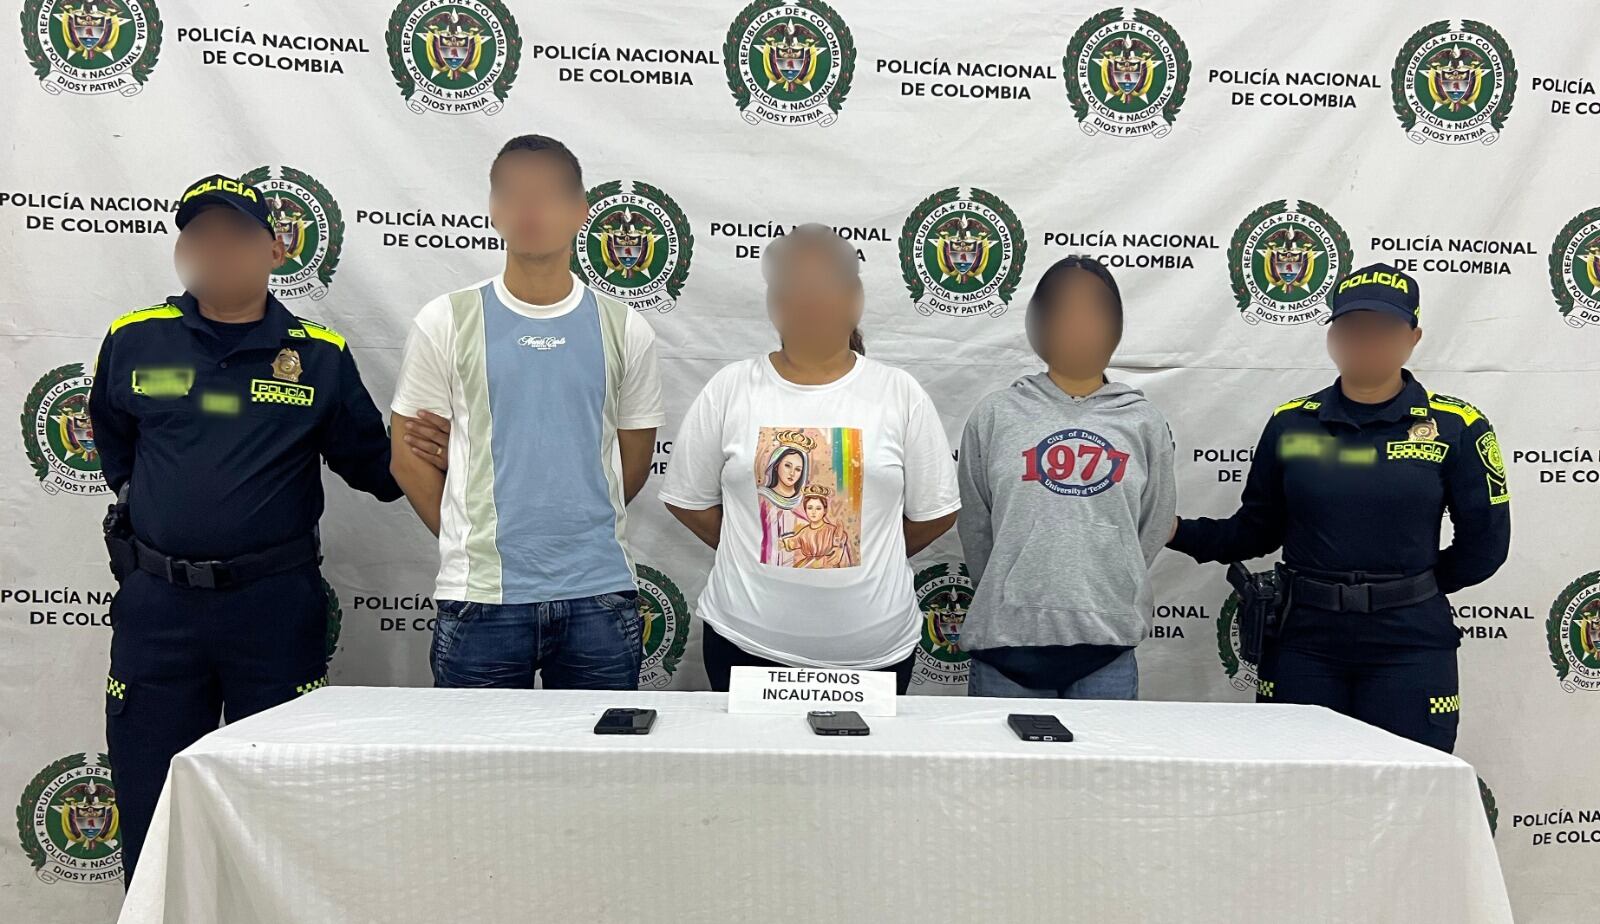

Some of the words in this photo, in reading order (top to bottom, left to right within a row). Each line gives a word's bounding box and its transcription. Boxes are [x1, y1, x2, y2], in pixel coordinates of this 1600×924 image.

[474, 4, 504, 56] COLOMBIA
[178, 26, 255, 45] POLICÍA
[263, 34, 369, 53] NACIONAL
[810, 15, 839, 68] COLOMBIA
[534, 43, 610, 60] POLICÍA
[617, 48, 719, 64] NACIONAL
[1147, 29, 1175, 81] COLOMBIA
[90, 52, 140, 78] NACIONAL
[203, 51, 226, 64] DE
[233, 52, 344, 74] COLOMBIA
[877, 58, 950, 75] POLICÍA
[958, 63, 1056, 79] NACIONAL
[1476, 39, 1502, 89] COLOMBIA
[90, 78, 126, 91] PATRIA
[455, 69, 500, 98] NACIONAL
[560, 68, 584, 82] DE
[590, 69, 693, 85] COLOMBIA
[1209, 68, 1280, 85] POLICÍA
[1286, 73, 1381, 88] NACIONAL
[902, 82, 925, 96] DE
[931, 84, 1030, 99] COLOMBIA
[1532, 78, 1595, 94] POLICÍA
[790, 80, 835, 110] NACIONAL
[1232, 92, 1254, 105] DE
[1260, 93, 1356, 108] COLOMBIA
[455, 97, 488, 111] PATRIA
[1127, 93, 1170, 121] NACIONAL
[1552, 100, 1570, 114] DE
[790, 109, 823, 122] PATRIA
[1455, 101, 1498, 130] NACIONAL
[1126, 120, 1158, 135] PATRIA
[1454, 128, 1486, 142] PATRIA
[0, 192, 84, 210] POLICÍA
[91, 197, 181, 212] NACIONA
[296, 188, 327, 241] COLOMBIA
[357, 209, 436, 226] POLICÍA
[27, 216, 54, 230] DE
[61, 218, 168, 234] COLOMBIA
[622, 196, 636, 204] DE
[647, 203, 676, 255] COLOMBIA
[711, 221, 785, 237] POLICÍA
[384, 234, 408, 247] DE
[415, 235, 504, 250] COLOMBI
[983, 209, 1010, 260] COLOMBIA
[1044, 230, 1117, 246] POLICÍA
[1123, 234, 1219, 248] NACIONAL
[736, 246, 760, 258] DE
[1309, 221, 1336, 270] COLOMBIA
[1372, 235, 1443, 251] POLICÍA
[1449, 239, 1537, 254] NACIONAL
[281, 254, 324, 284] NACIONAL
[1098, 255, 1194, 268] COLOMBIA
[1394, 259, 1417, 272] DE
[1423, 260, 1511, 274] COLOMBIA
[281, 282, 314, 296] PATRIA
[629, 267, 673, 296] NACIONAL
[962, 272, 1006, 301] NACIONAL
[1339, 271, 1409, 294] POLICÍA
[1289, 281, 1332, 310] NACIONAL
[962, 300, 994, 313] PATRIA
[1288, 309, 1321, 322] PATRIA
[259, 384, 306, 398] POLICÍA
[1047, 434, 1063, 444] City
[1082, 432, 1106, 446] Dallas
[1194, 446, 1254, 462] POLICÍ
[1393, 443, 1442, 456] POLICÍA
[1514, 447, 1593, 463] POLICÍA
[1022, 444, 1130, 483] 1977
[1218, 470, 1241, 482] DE
[1540, 470, 1566, 482] DE
[1045, 479, 1081, 496] University
[1088, 479, 1109, 493] Texas
[2, 587, 81, 604] POLICÍA
[354, 594, 434, 610] POLICÍA
[645, 584, 673, 632] COLOMBIA
[1450, 606, 1534, 619] ACIONAL
[30, 612, 56, 624] DE
[381, 618, 406, 631] DE
[768, 668, 860, 684] TELÉFONOS
[763, 688, 864, 702] INCAUTADOS
[1514, 809, 1574, 827] POLICÍA
[1533, 833, 1552, 845] DE
